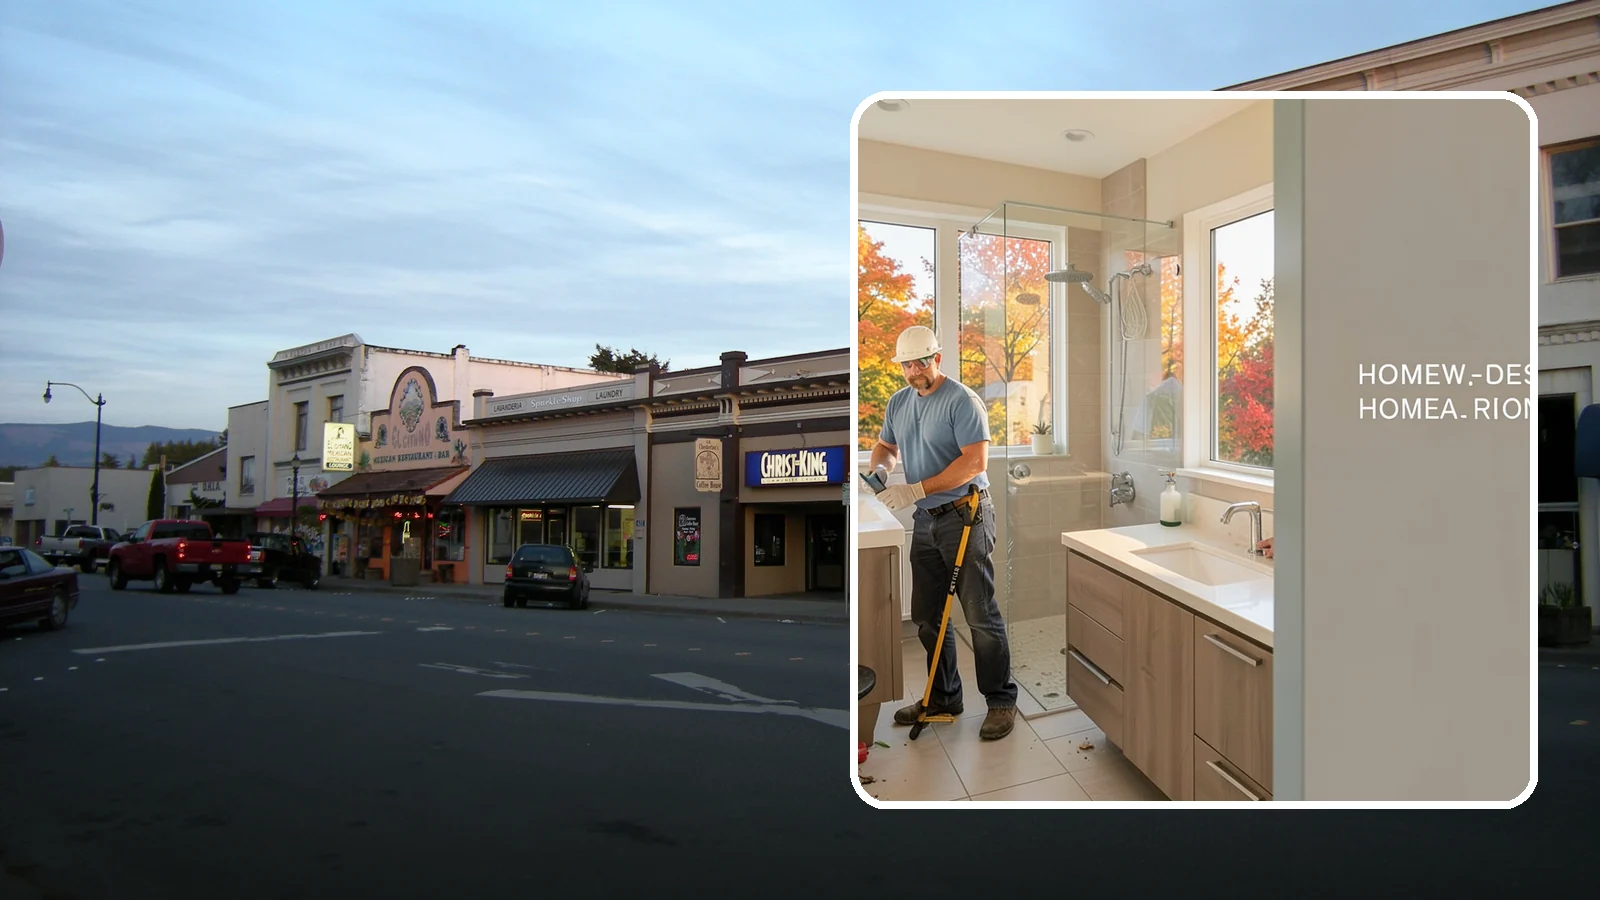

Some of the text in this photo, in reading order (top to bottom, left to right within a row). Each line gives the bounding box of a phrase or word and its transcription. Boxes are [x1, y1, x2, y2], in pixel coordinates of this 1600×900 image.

[561, 394, 583, 404] Shop
[595, 389, 624, 400] LAUNDRY
[493, 402, 523, 413] LAVANDERIA
[391, 425, 402, 449] EL
[373, 455, 396, 464] MEXICAN
[397, 451, 434, 462] RESTAURANT
[438, 450, 450, 459] BAR
[760, 450, 827, 478] CHRIST KING
